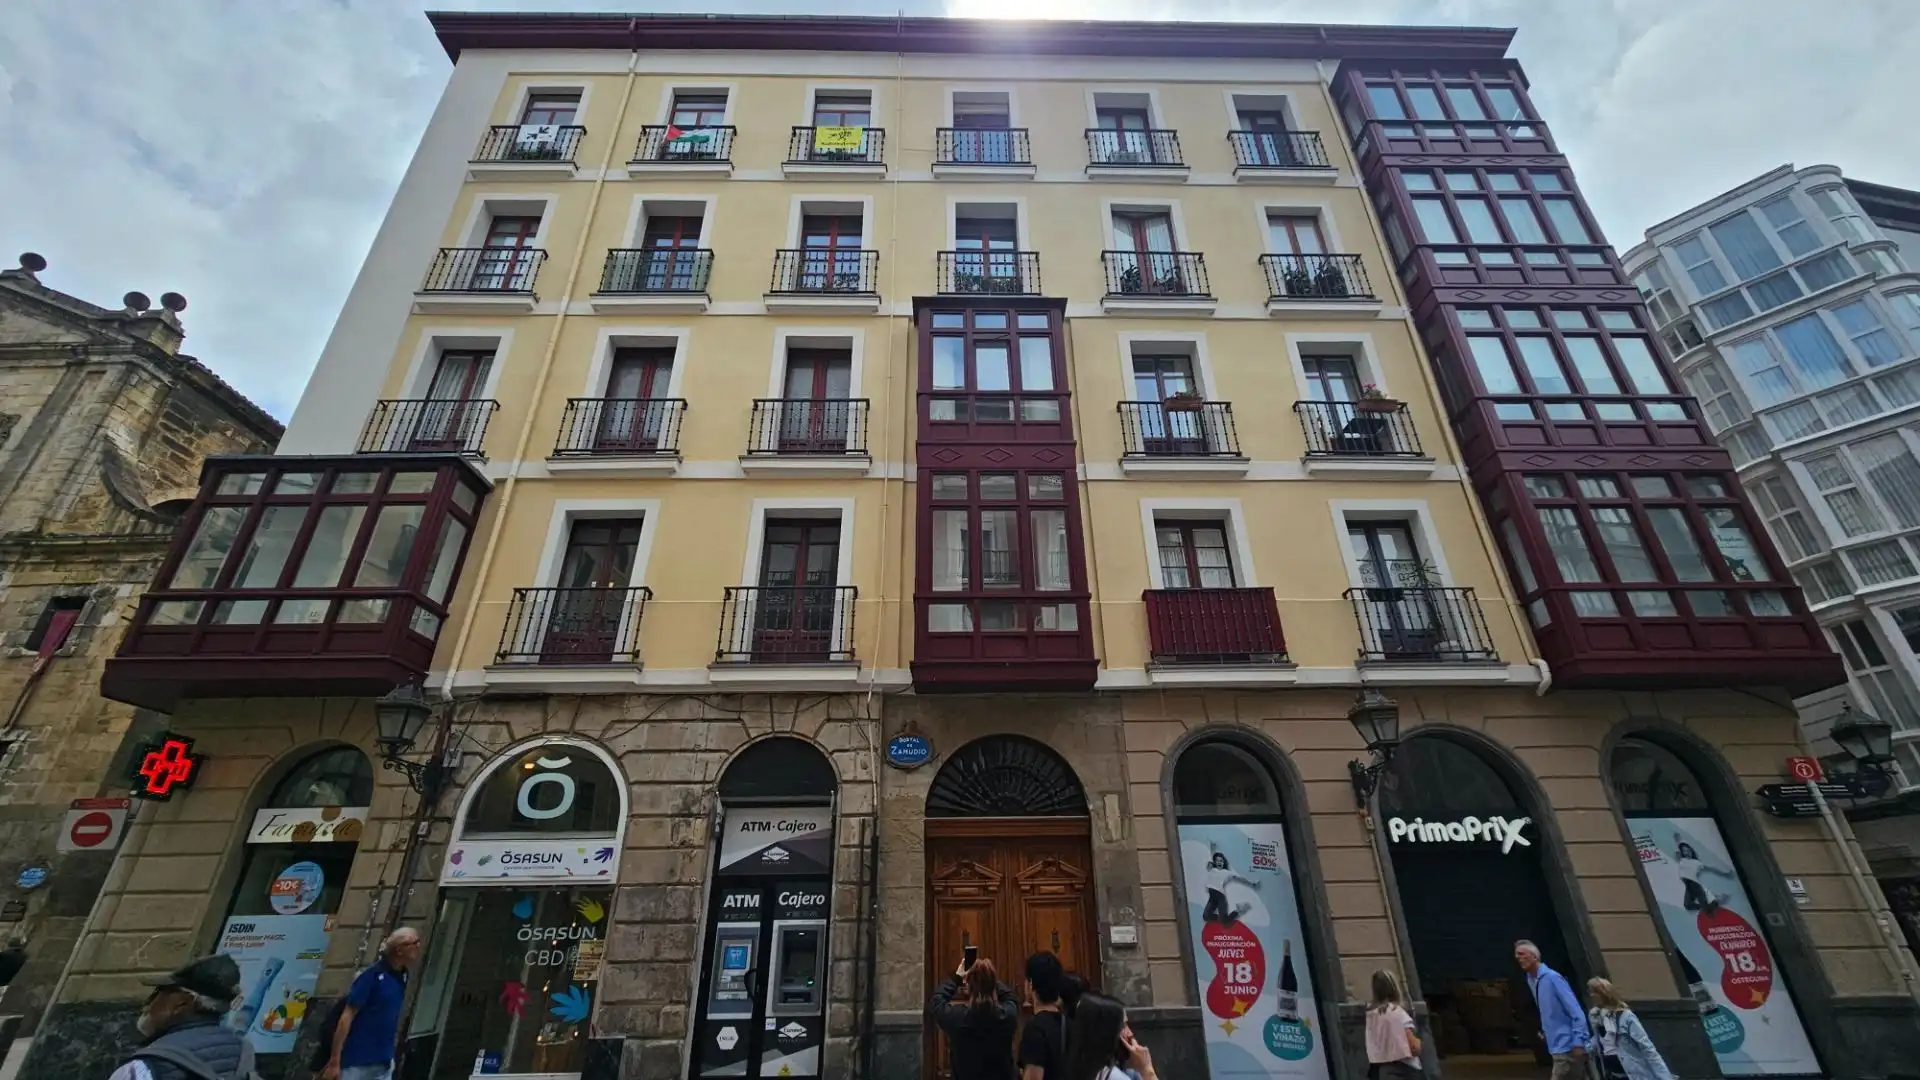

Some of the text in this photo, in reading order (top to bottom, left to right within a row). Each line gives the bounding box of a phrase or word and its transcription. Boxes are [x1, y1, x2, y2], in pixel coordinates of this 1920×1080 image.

[891, 745, 927, 755] ZAMUDIO
[723, 894, 760, 908] ATM
[778, 891, 825, 908] Cajero
[228, 923, 256, 934] ISDIN
[524, 950, 564, 966] CBD
[1218, 949, 1245, 959] JUEVES
[1223, 962, 1252, 984] 18
[1224, 985, 1258, 995] JUNIO
